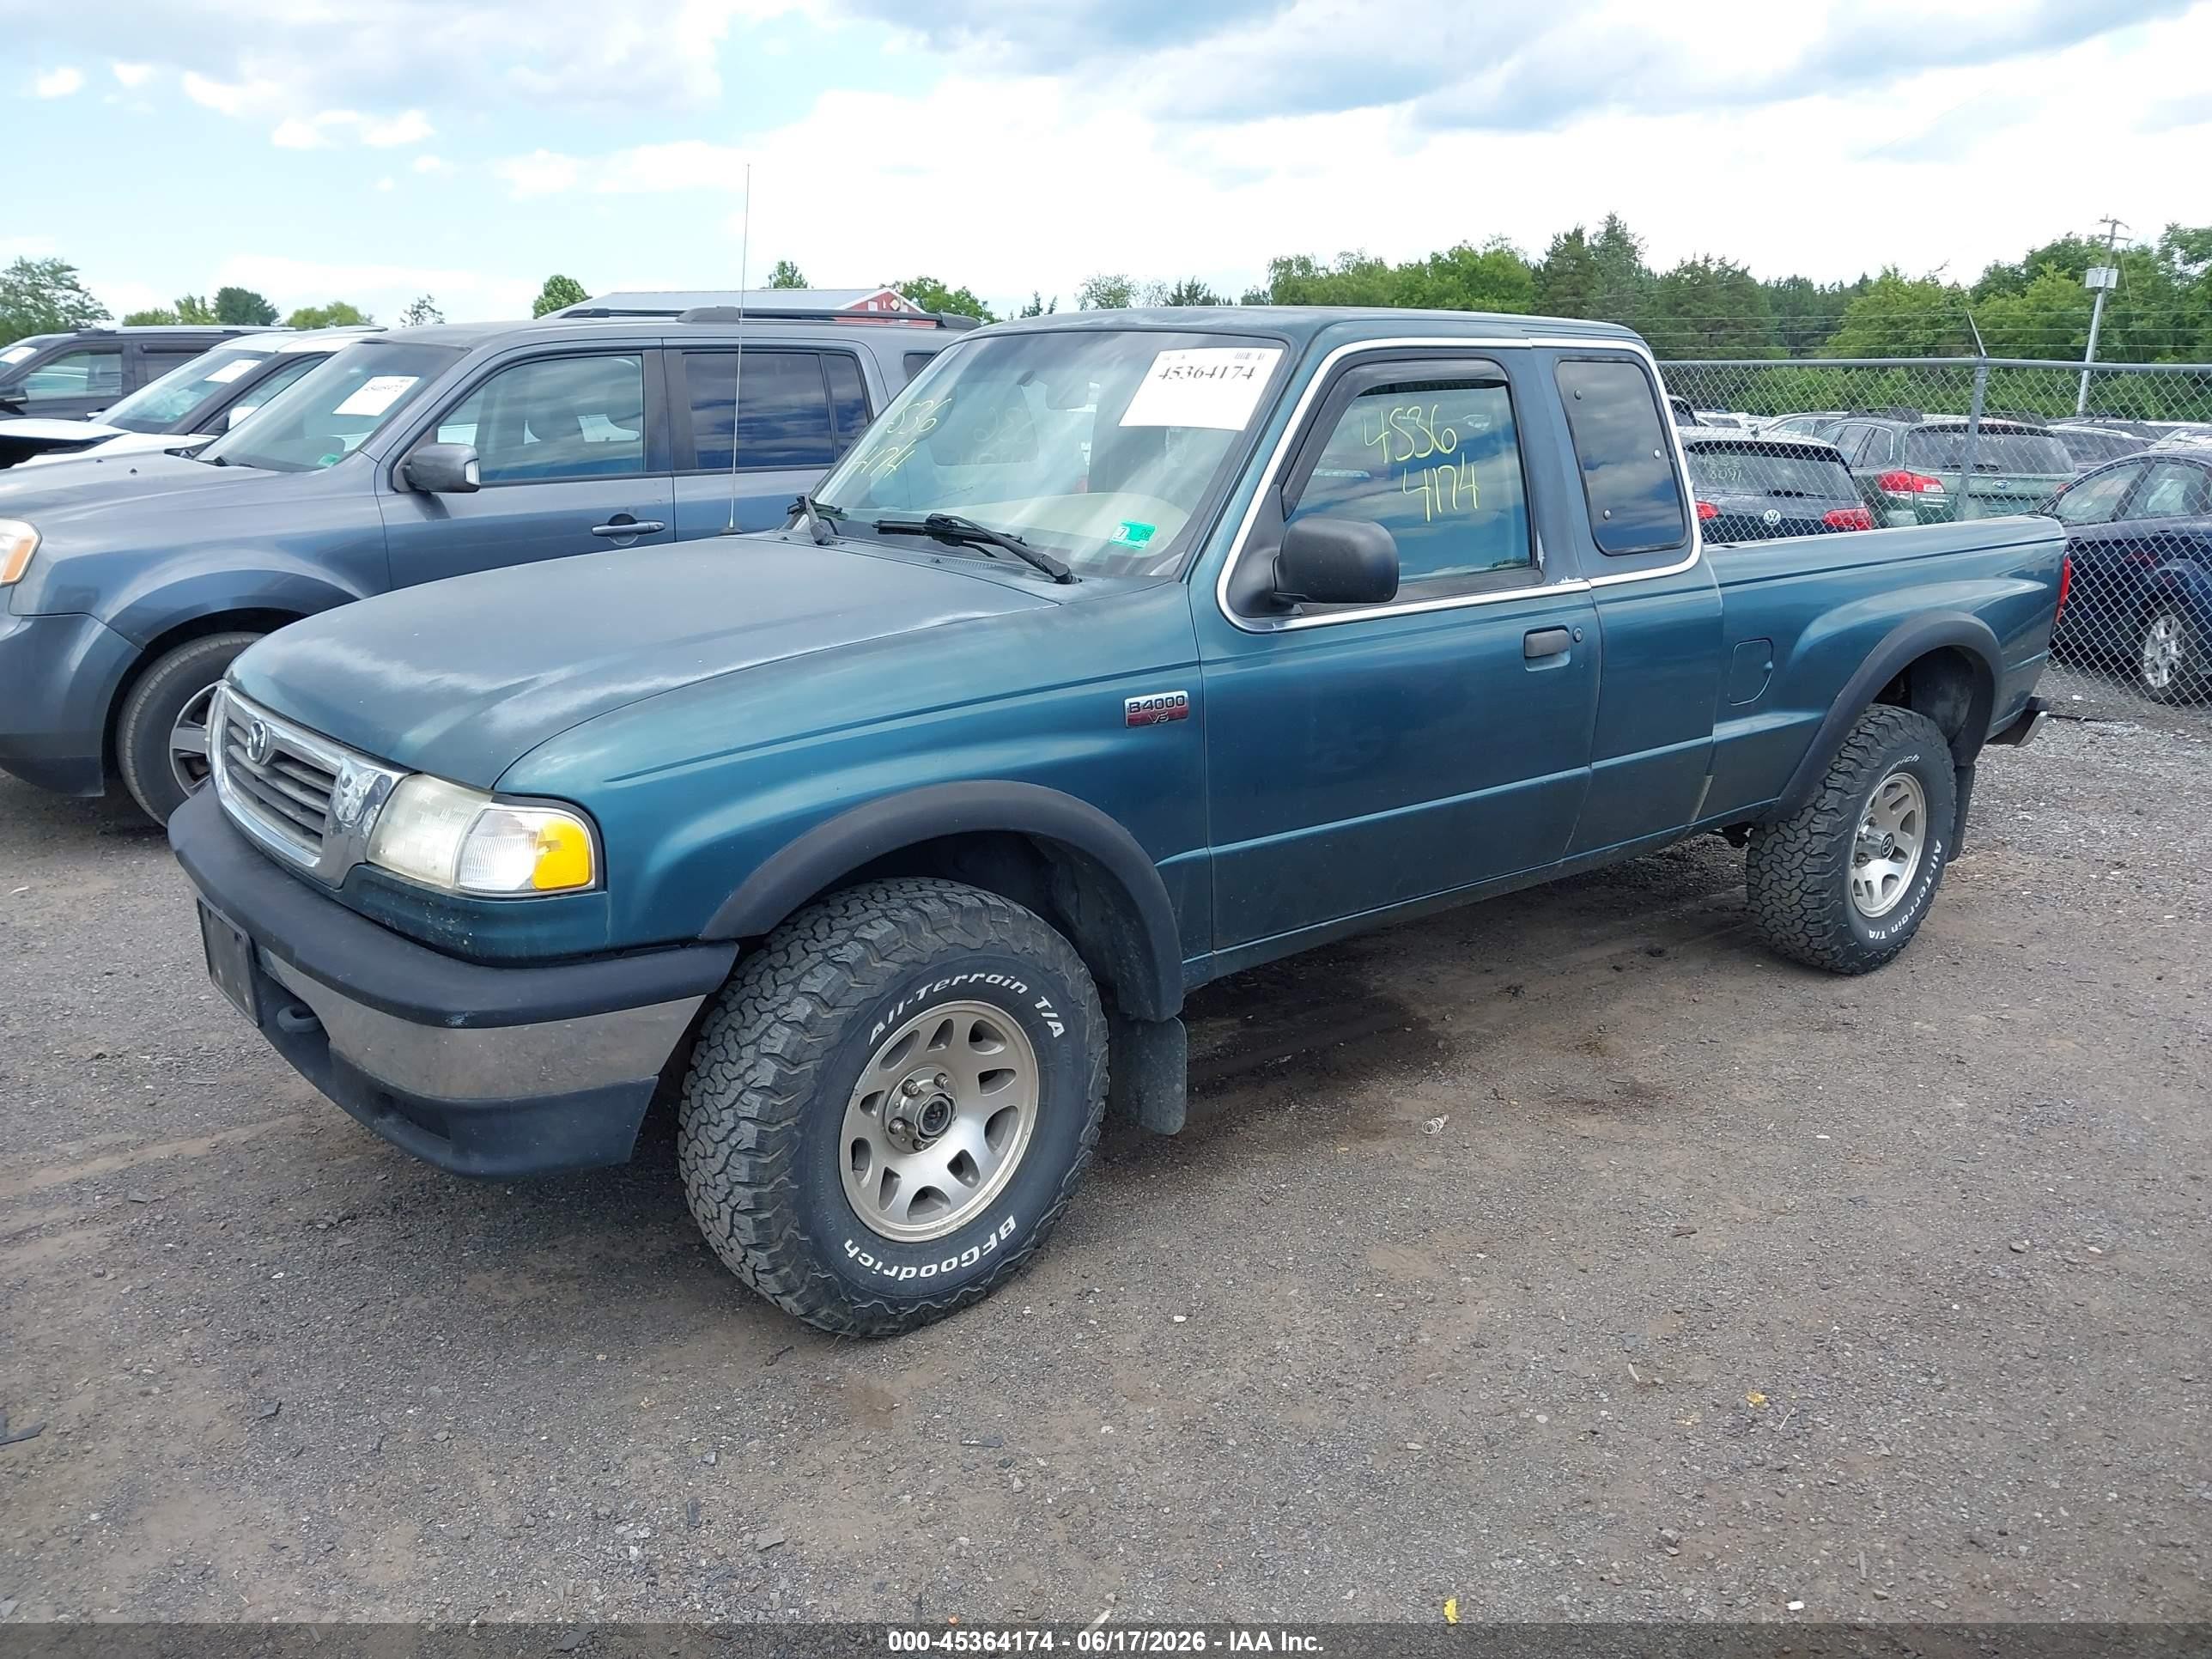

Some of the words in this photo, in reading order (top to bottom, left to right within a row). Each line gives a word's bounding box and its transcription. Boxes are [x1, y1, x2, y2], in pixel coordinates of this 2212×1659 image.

[1158, 365, 1257, 380] 45364174
[1362, 404, 1457, 465] 4536
[1401, 452, 1480, 522] 4174
[1117, 527, 1127, 538] 7
[1139, 529, 1152, 538] 26
[1128, 695, 1186, 714] B4000
[1148, 712, 1170, 723] V6
[1891, 839, 1942, 934] All-Terrain
[868, 971, 1029, 1046] All-Terrain
[1033, 995, 1066, 1040] T/A
[843, 1214, 1018, 1282] BFGoodrich
